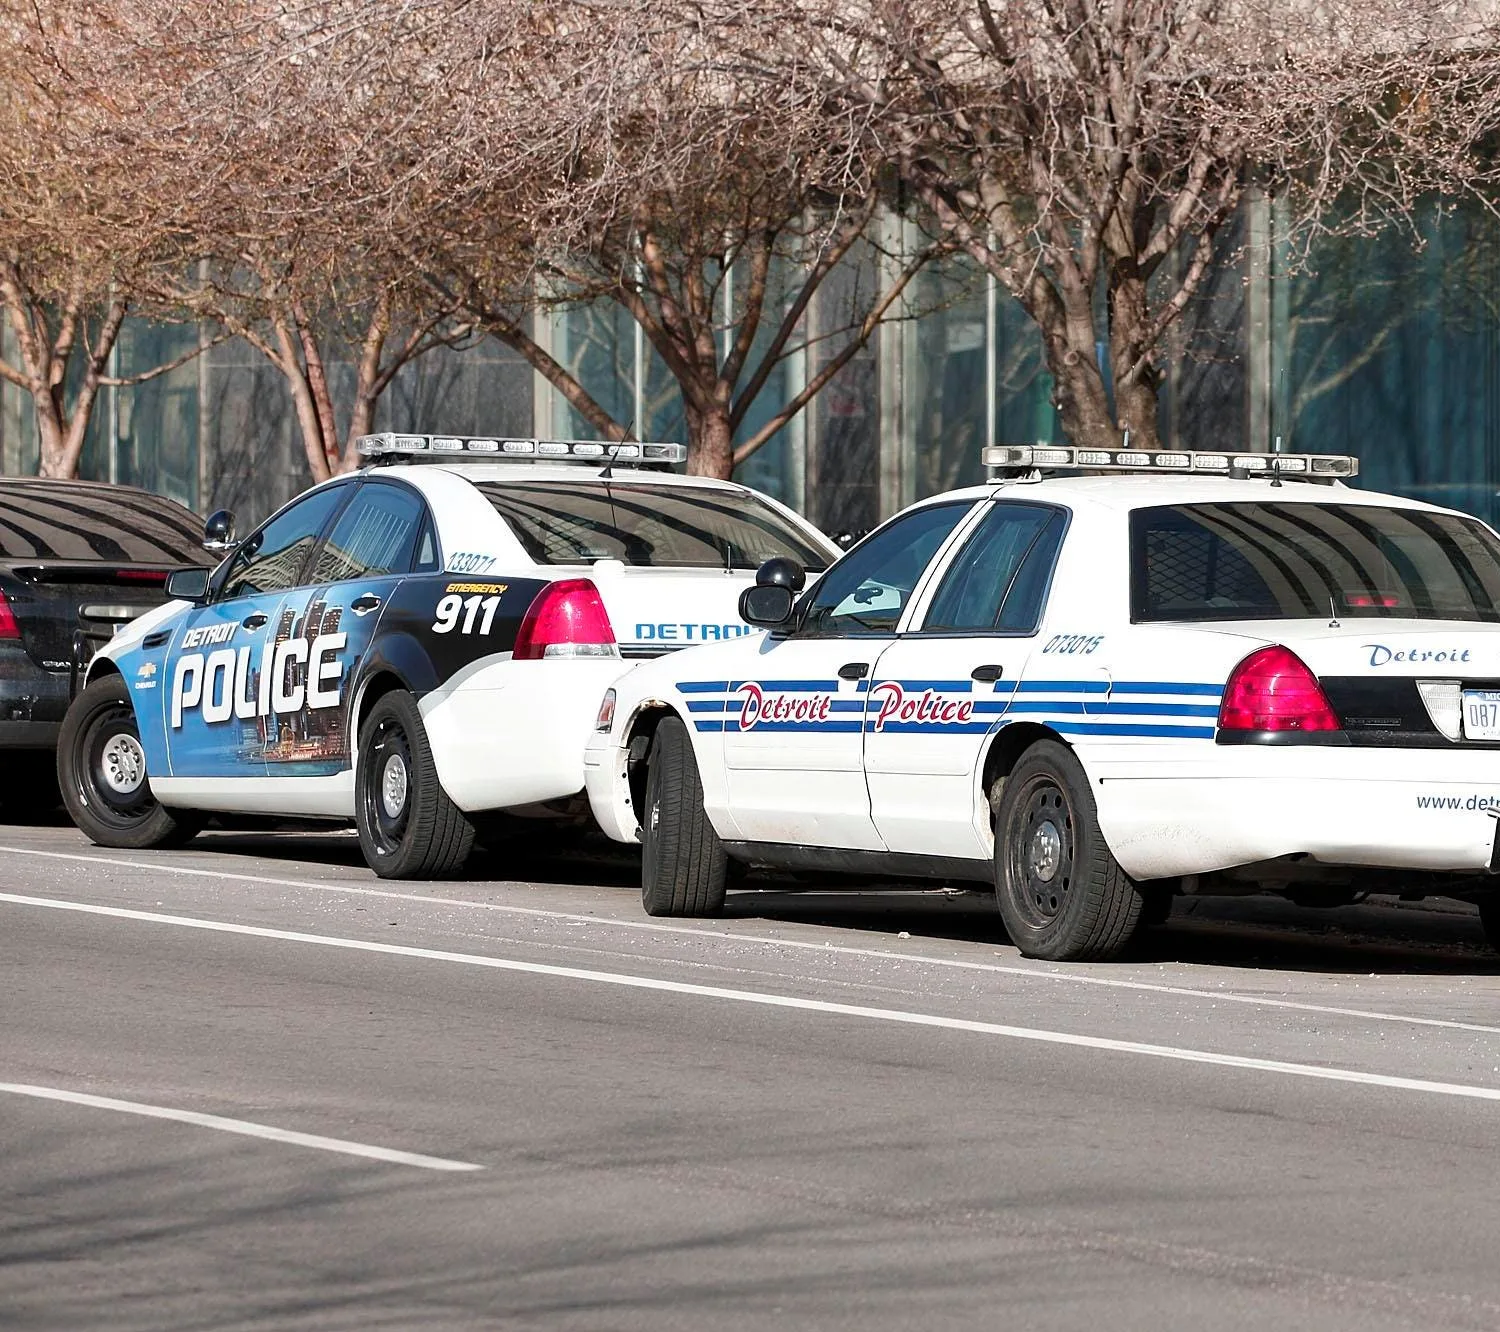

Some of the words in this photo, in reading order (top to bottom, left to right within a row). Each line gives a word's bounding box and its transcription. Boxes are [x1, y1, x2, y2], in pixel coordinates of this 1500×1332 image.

[446, 552, 498, 573] 133071
[445, 583, 509, 594] EMERGENCY
[431, 594, 502, 636] 911
[181, 621, 241, 649] DETROIT
[635, 623, 763, 641] DETROI
[1042, 634, 1105, 655] 073015
[1360, 644, 1471, 667] Detroit
[171, 632, 347, 728] POLICE
[738, 682, 831, 729] Detroit
[873, 684, 973, 730] Police
